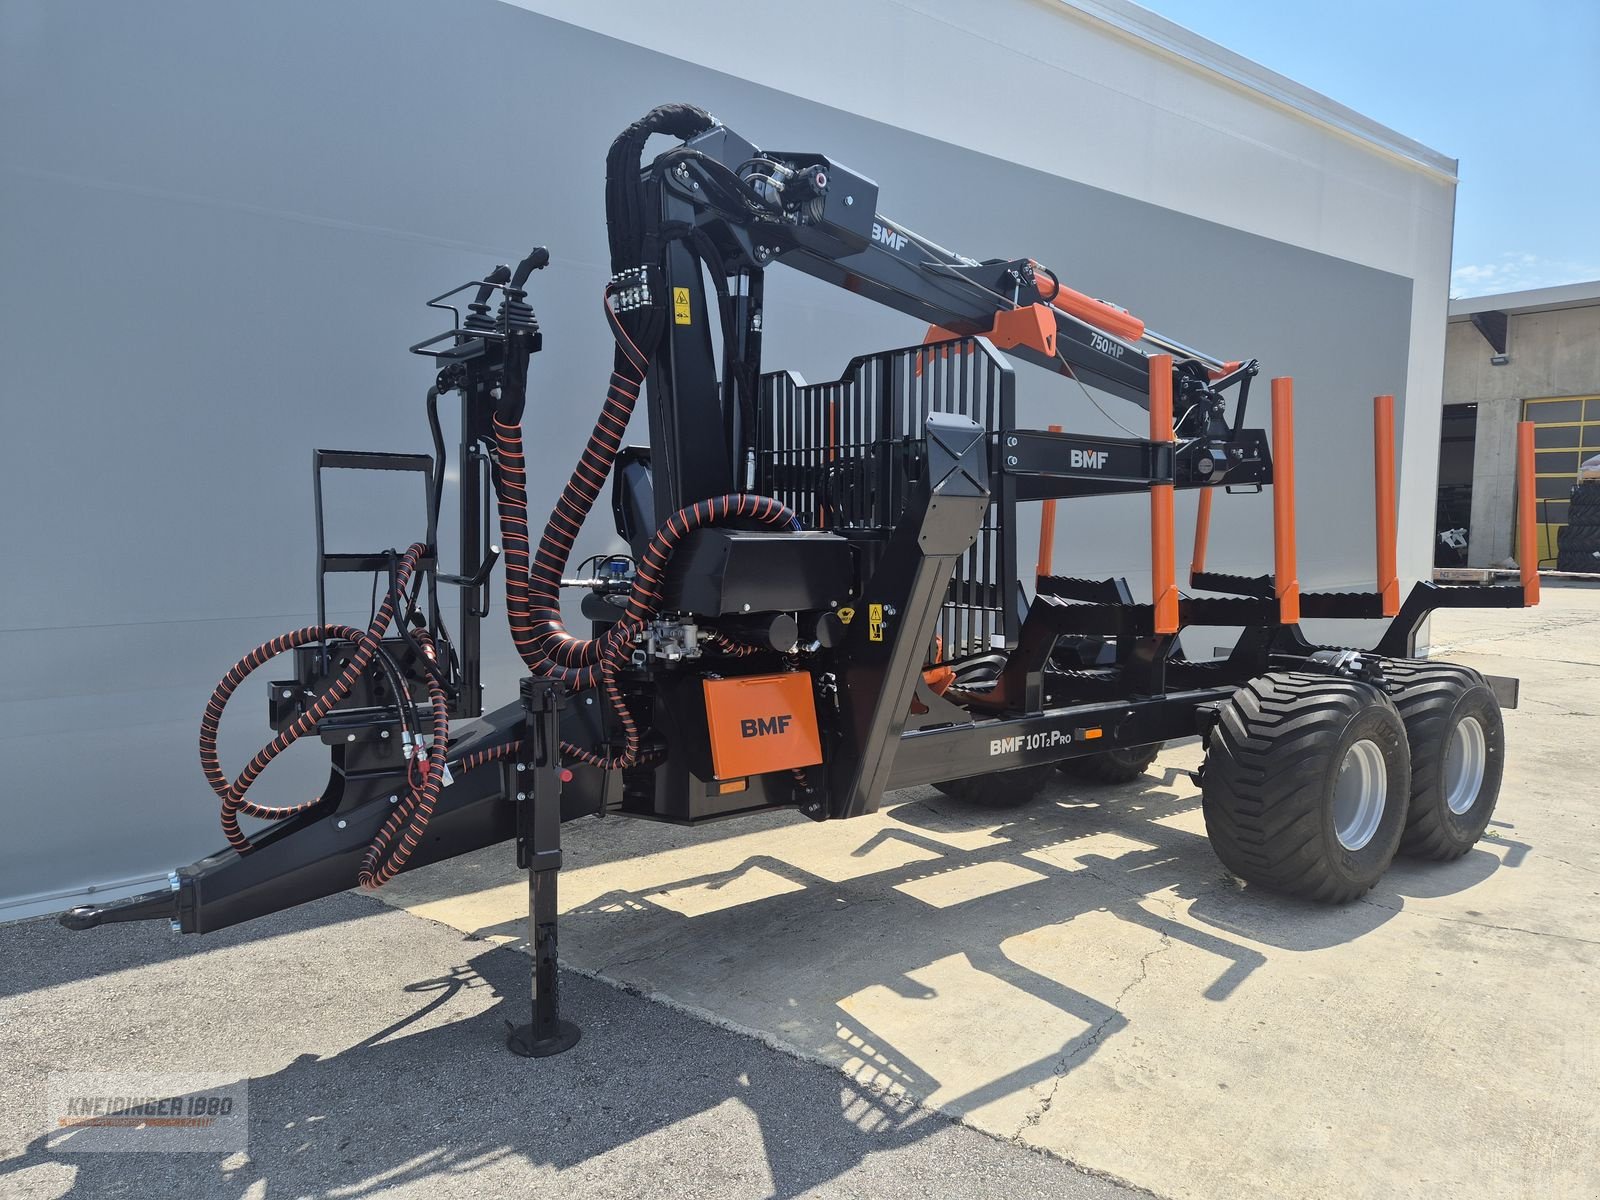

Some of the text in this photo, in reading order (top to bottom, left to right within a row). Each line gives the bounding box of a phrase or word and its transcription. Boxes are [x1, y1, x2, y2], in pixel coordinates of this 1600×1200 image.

[871, 222, 909, 251] BMF
[1090, 332, 1124, 358] 750HP
[1070, 449, 1109, 469] BMF
[740, 715, 792, 738] BMF
[990, 736, 1025, 756] BMF
